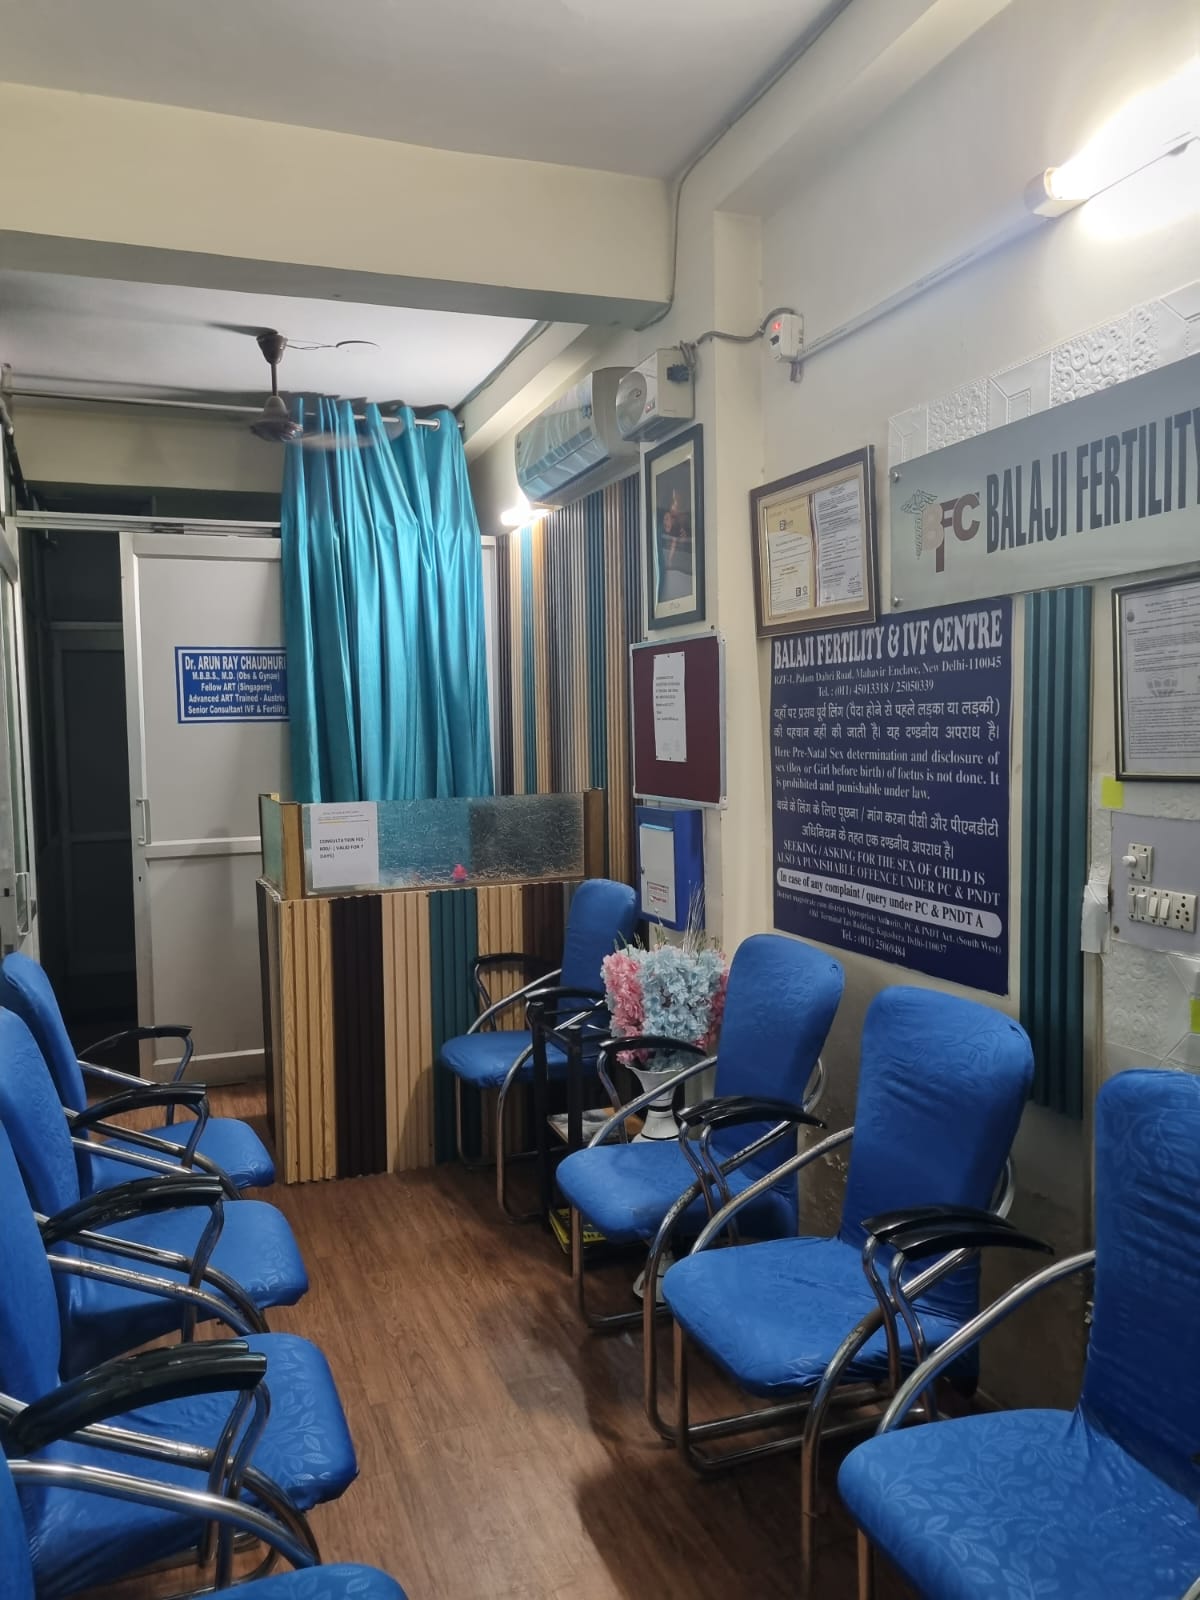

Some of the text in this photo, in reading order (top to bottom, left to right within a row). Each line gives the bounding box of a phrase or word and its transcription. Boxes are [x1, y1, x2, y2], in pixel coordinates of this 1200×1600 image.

[987, 451, 1067, 553] BALAJI
[774, 609, 1003, 670] BALAJI FERTILITY & IVF CENTRE
[184, 655, 196, 670] Dr.
[198, 655, 220, 670] ARUN
[223, 655, 238, 670] RAY
[923, 661, 939, 673] New
[942, 655, 1002, 672] Delhi-110045
[189, 694, 219, 703] Advanced
[221, 694, 233, 702] ART
[201, 683, 221, 692] Fellow
[223, 683, 236, 692] ART
[188, 705, 208, 714] Senior
[209, 704, 243, 713] Consultant
[245, 704, 255, 712] IVF
[788, 708, 797, 718] पर
[866, 700, 882, 718] होने
[884, 700, 893, 716] से
[895, 699, 916, 718] पहले
[918, 702, 944, 718] लड़का
[947, 701, 959, 714] या
[962, 695, 1000, 717] लड़की)
[847, 722, 866, 738] जाती
[887, 726, 900, 740] यह
[905, 721, 939, 739] दण्डनीय
[945, 726, 981, 739] अपराध
[775, 746, 1001, 765] Here Pre-Natal Sex determination and disclosure of
[803, 766, 812, 774] or
[813, 763, 830, 775] Girl
[831, 763, 858, 777] before
[860, 764, 885, 778] birth)
[887, 766, 897, 779] of
[898, 766, 924, 780] foetus
[926, 768, 934, 781] is
[937, 771, 953, 783] not
[955, 769, 987, 785] done.
[990, 771, 1000, 785] It
[782, 777, 818, 790] prohibited
[819, 780, 835, 792] and
[837, 781, 882, 796] punishable
[884, 785, 910, 798] under
[912, 786, 930, 800] law.
[813, 800, 820, 815] के
[821, 801, 837, 818] लिए
[838, 806, 859, 823] पूछना
[884, 811, 906, 825] करना
[930, 812, 948, 831] और
[950, 814, 999, 838] पीएनडीटी
[838, 826, 847, 841] के
[911, 841, 942, 858] अपराध
[783, 840, 817, 855] SEEKING
[823, 847, 856, 862] ASKING
[857, 851, 875, 866] FOR
[878, 854, 896, 869] THE
[897, 859, 916, 873] SEX
[918, 863, 932, 876] OF
[934, 865, 971, 883] CHILD
[974, 871, 986, 886] IS
[803, 856, 855, 876] PUNISHABLE
[857, 865, 898, 886] OFFENCE
[900, 874, 936, 894] UNDER
[937, 882, 953, 896] PC
[955, 885, 964, 900] &
[966, 886, 1001, 906] PNDT
[779, 870, 788, 881] In
[788, 875, 802, 885] case
[802, 875, 811, 886] of
[810, 880, 824, 893] any
[824, 882, 861, 898] complaint
[866, 893, 888, 909] query
[889, 897, 913, 912] under
[915, 899, 930, 916] PC
[931, 904, 940, 919] &
[942, 905, 974, 926] PNDT
[975, 913, 984, 929] A
